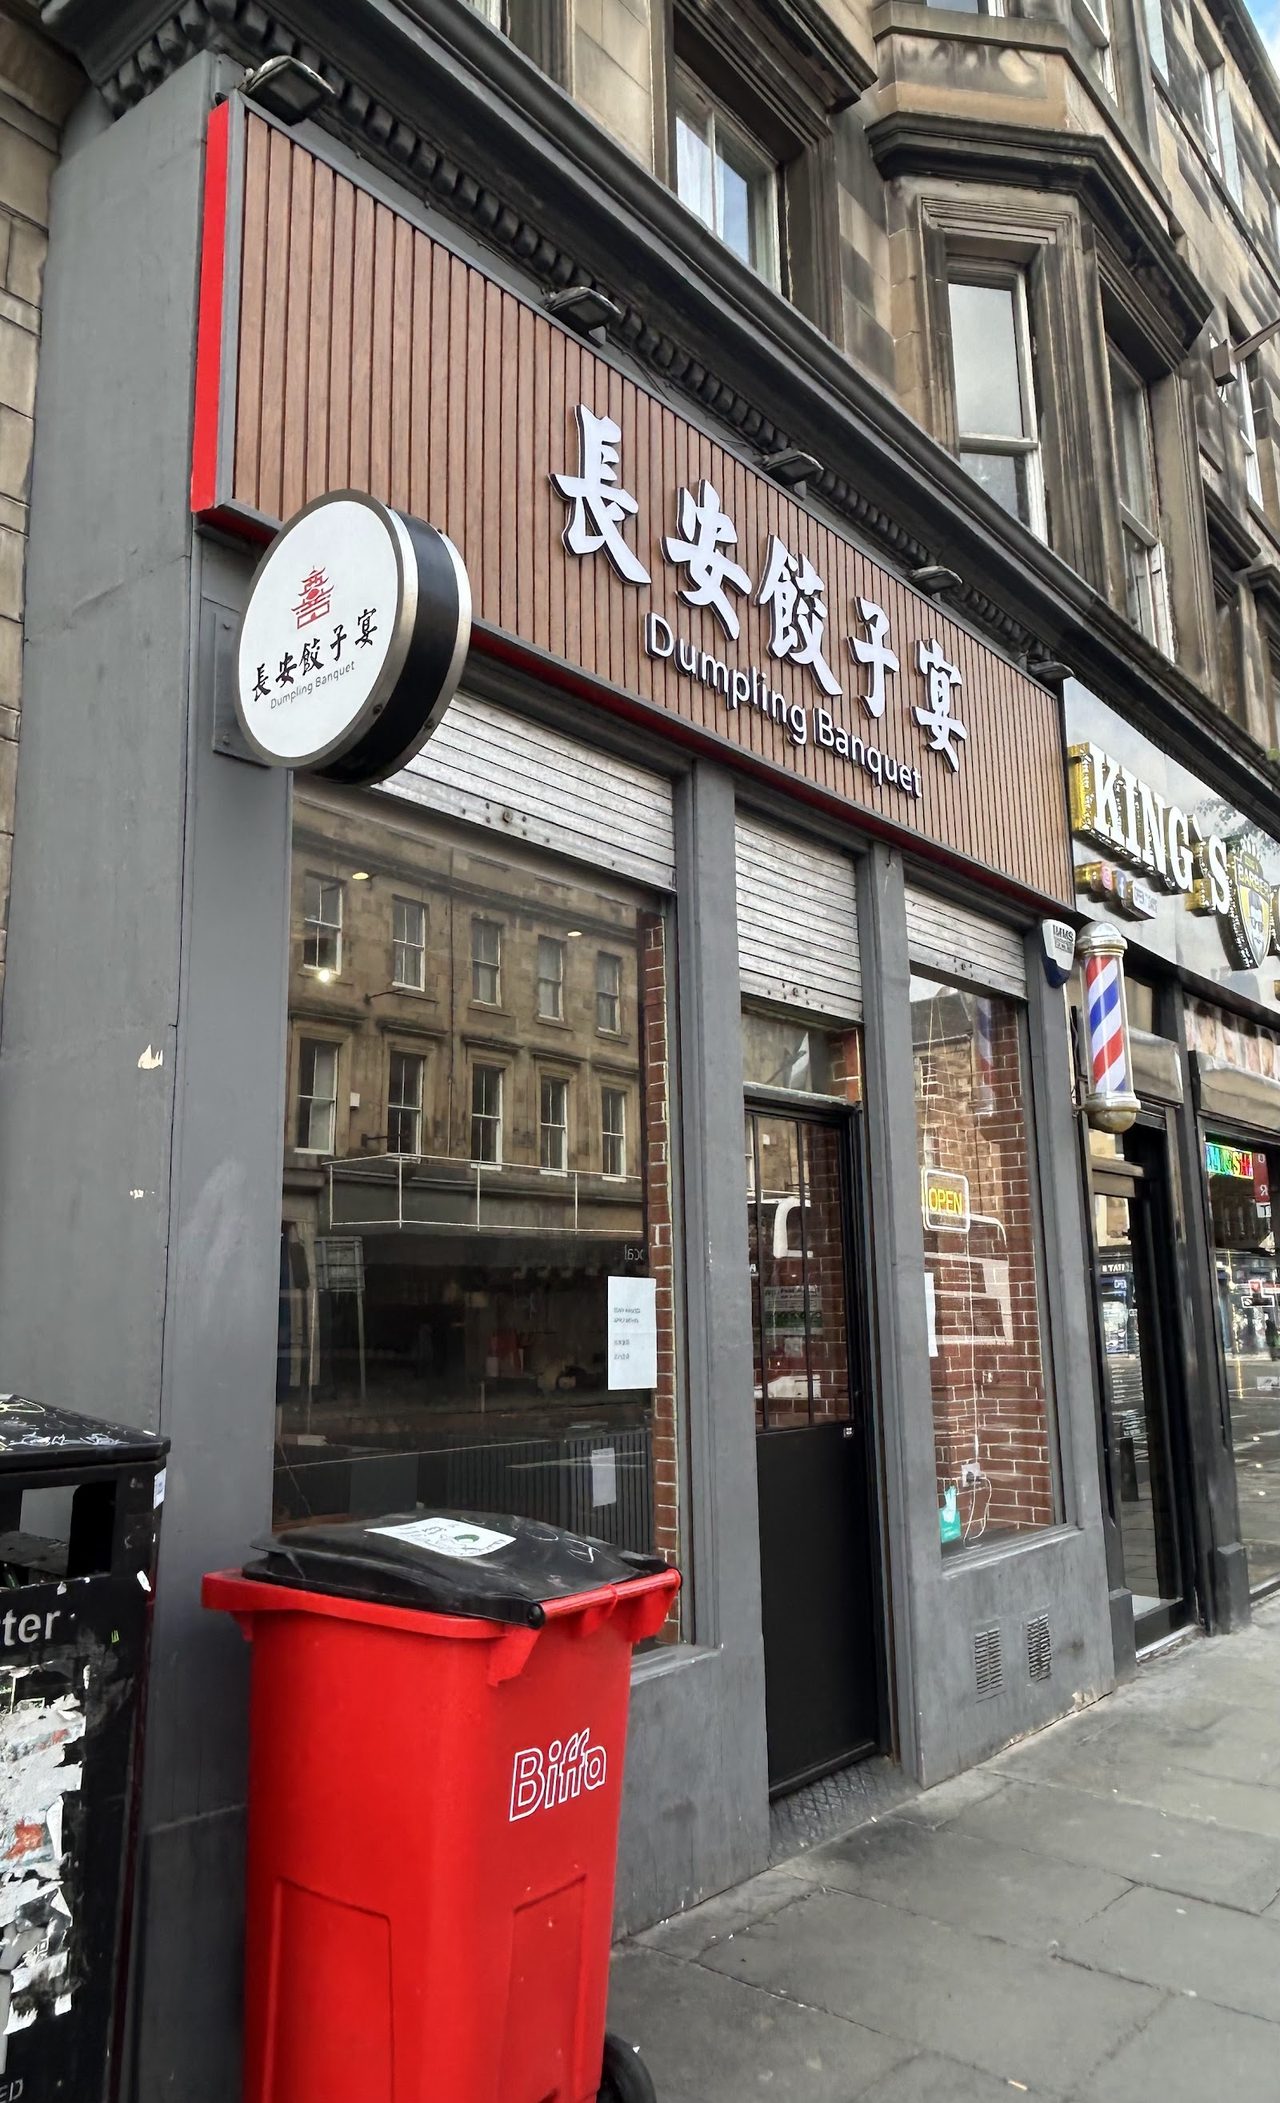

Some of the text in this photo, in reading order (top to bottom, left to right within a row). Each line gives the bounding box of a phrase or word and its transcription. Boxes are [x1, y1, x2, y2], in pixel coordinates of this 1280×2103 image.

[549, 403, 968, 773] 長安餃子宴
[252, 608, 378, 702] 長安餃子宴
[270, 661, 355, 709] Dumpling Banquet
[643, 612, 923, 799] Dumpling Banquet
[1067, 741, 1230, 916] KING'S
[928, 1187, 963, 1216] OPEN
[510, 1727, 608, 1822] Biffa
